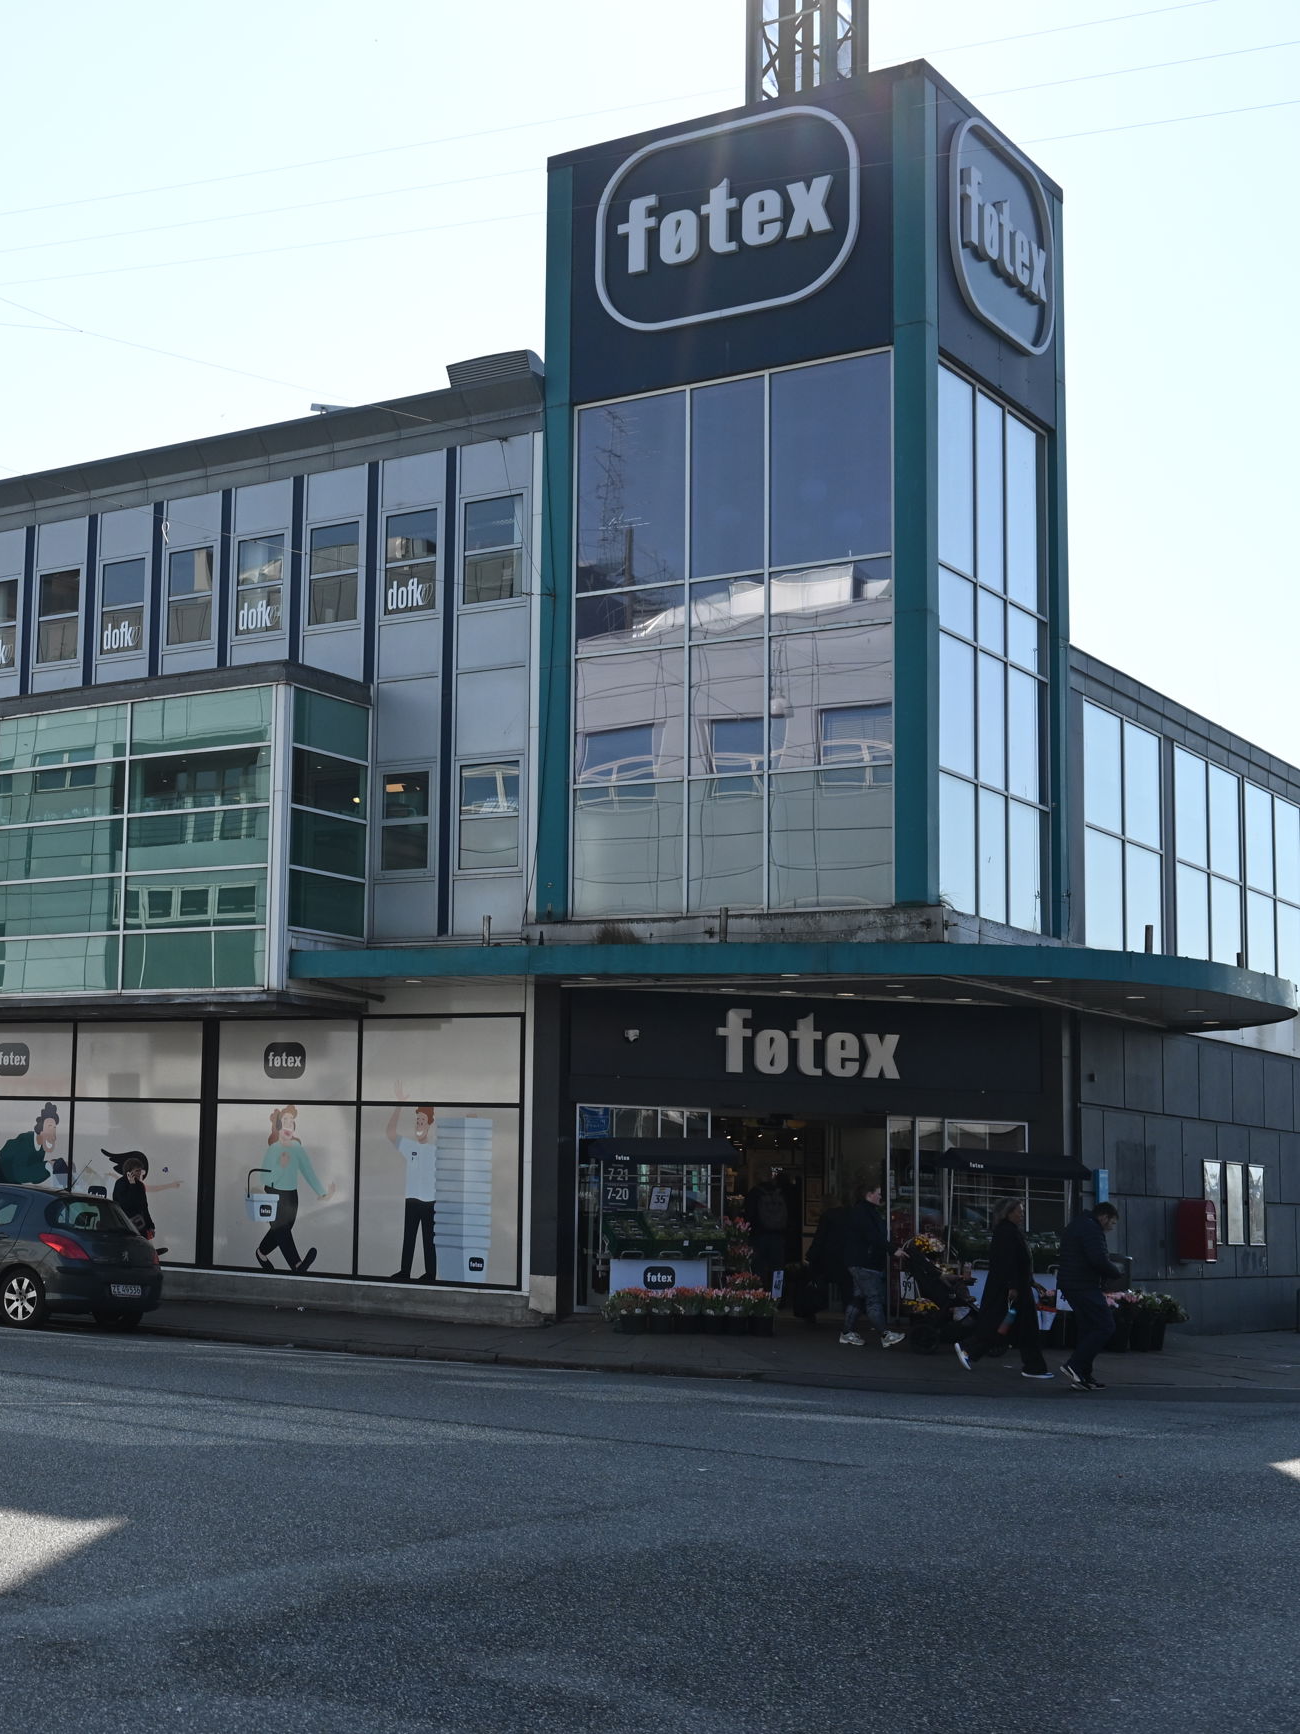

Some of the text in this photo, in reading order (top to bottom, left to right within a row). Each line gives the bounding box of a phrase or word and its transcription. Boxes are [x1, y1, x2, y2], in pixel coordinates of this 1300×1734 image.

[616, 174, 835, 275] føtex
[959, 166, 1048, 304] føtex
[268, 1052, 301, 1067] føtex
[716, 1008, 900, 1079] føtex
[646, 1272, 673, 1283] føtex
